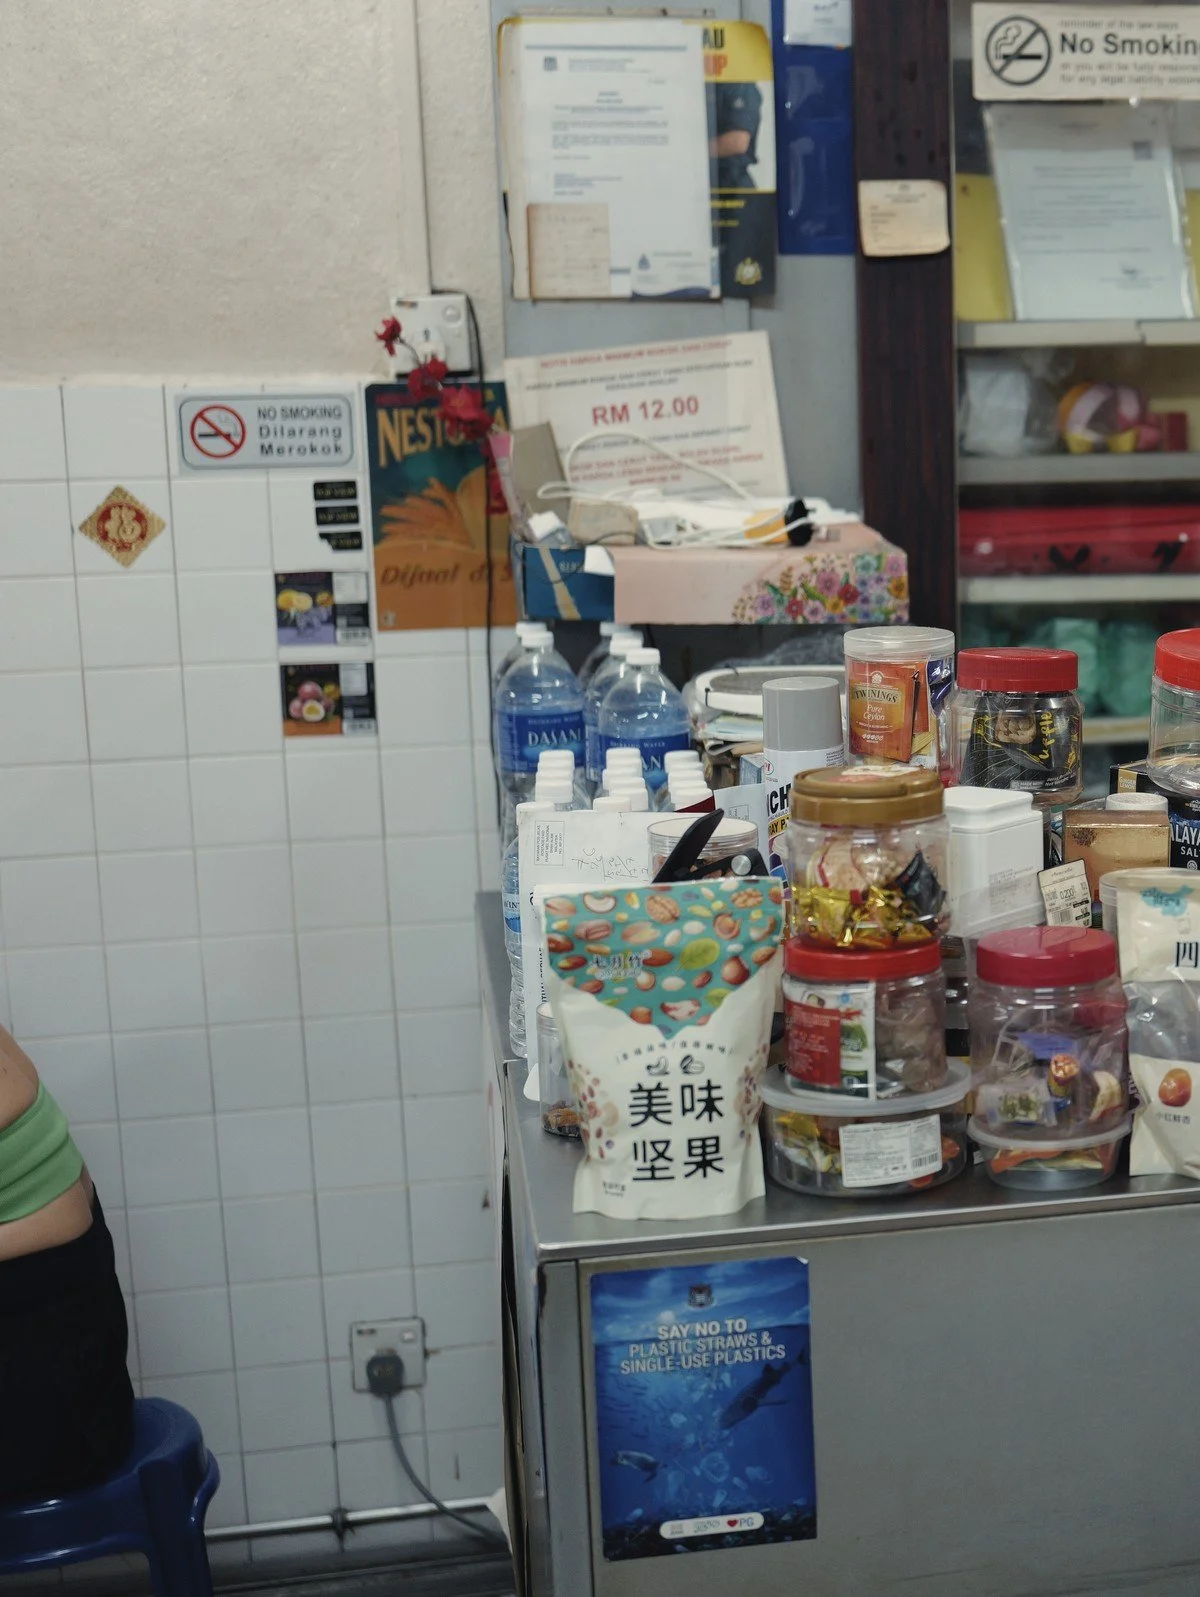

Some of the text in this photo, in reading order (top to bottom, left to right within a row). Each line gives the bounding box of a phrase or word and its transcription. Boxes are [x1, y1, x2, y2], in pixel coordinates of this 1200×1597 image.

[1060, 33, 1094, 54] No
[257, 405, 343, 420] NO SMOKING
[592, 395, 699, 426] RM 12.00
[259, 424, 343, 440] Dilarang
[260, 442, 343, 457] Merokok
[854, 688, 899, 703] TWININGS
[863, 712, 886, 722] Ceylon
[867, 704, 883, 714] Pure
[629, 1079, 724, 1127] 美味
[632, 1135, 724, 1181] 坚果
[658, 1318, 747, 1340] SAY NO TO
[629, 1331, 772, 1357] PLASTIC STRAWS &
[620, 1345, 786, 1375] SINGLE-USE PLASTICS
[739, 1516, 755, 1529] PG
